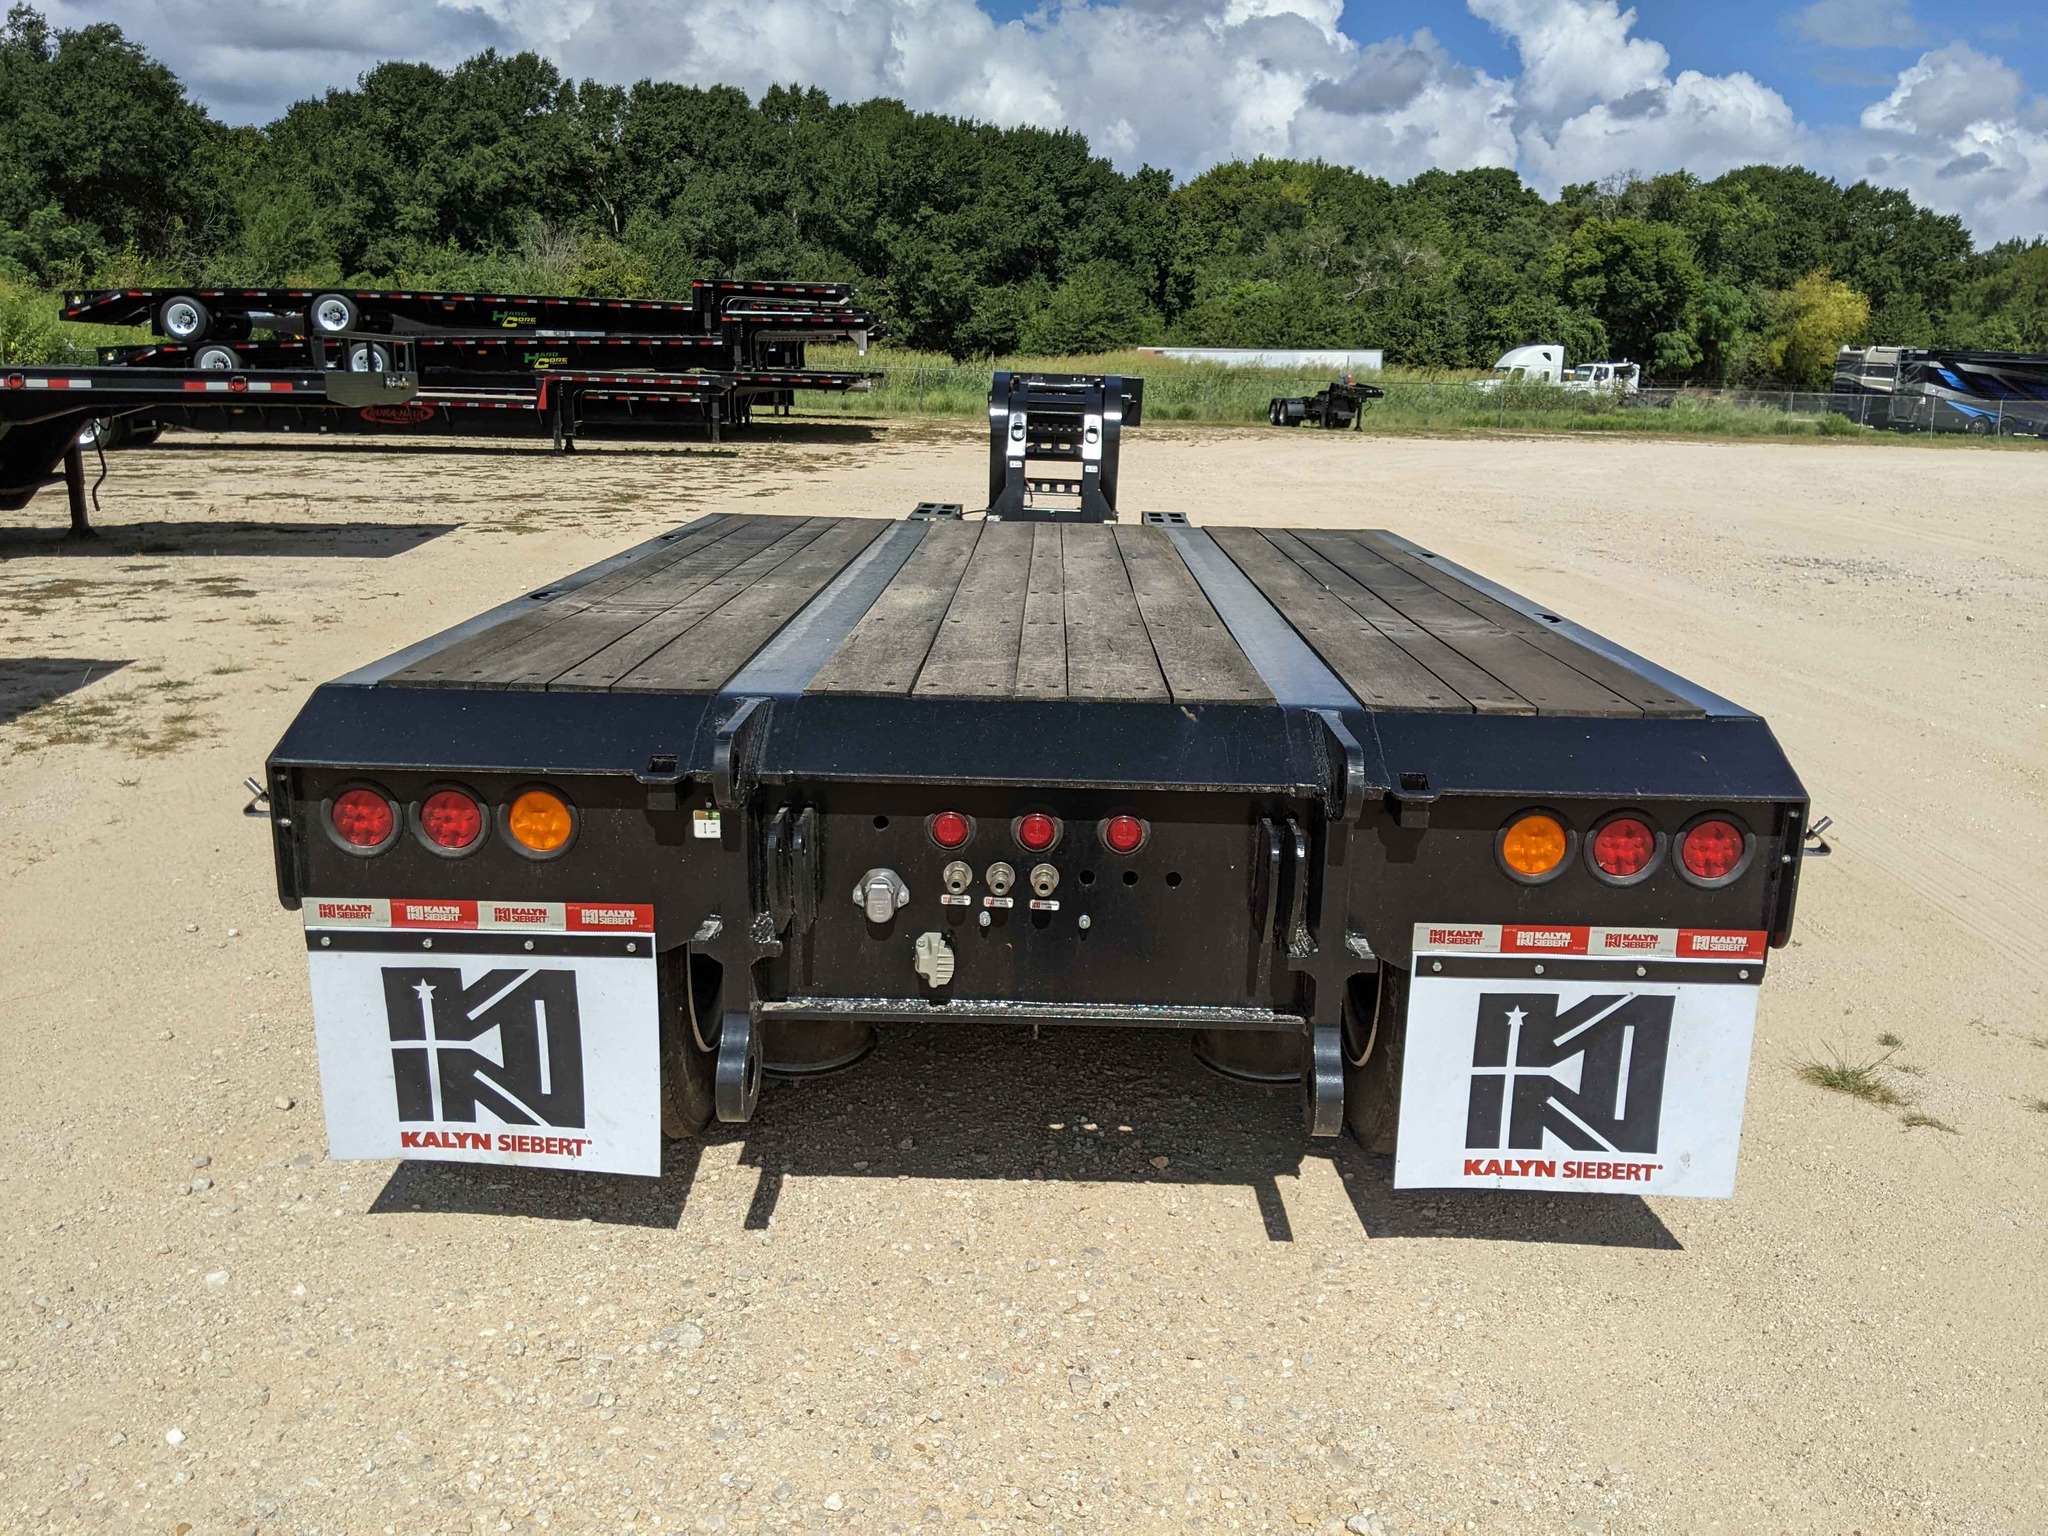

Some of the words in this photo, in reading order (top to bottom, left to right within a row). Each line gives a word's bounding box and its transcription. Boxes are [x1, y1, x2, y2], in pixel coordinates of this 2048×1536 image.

[502, 316, 537, 328] CORE
[533, 358, 568, 369] CORE
[336, 904, 372, 912] KALYN
[424, 906, 460, 914] KALYN
[336, 912, 372, 920] SIEBERT
[599, 909, 635, 917] KALYN
[511, 915, 547, 923] SIEBERT
[599, 917, 635, 925] SIEBERT
[1446, 930, 1483, 938] KALYN
[1534, 932, 1571, 940] KALYN
[1622, 933, 1659, 941] KALYN
[1446, 937, 1482, 945] SIEBERT
[1710, 936, 1747, 944] KALYN
[1622, 941, 1658, 949] SIEBERT
[401, 1131, 492, 1150] KALYN
[498, 1135, 586, 1156] SIEBERT
[1464, 1159, 1556, 1177] KALYN
[1562, 1161, 1656, 1181] SIEBERT
